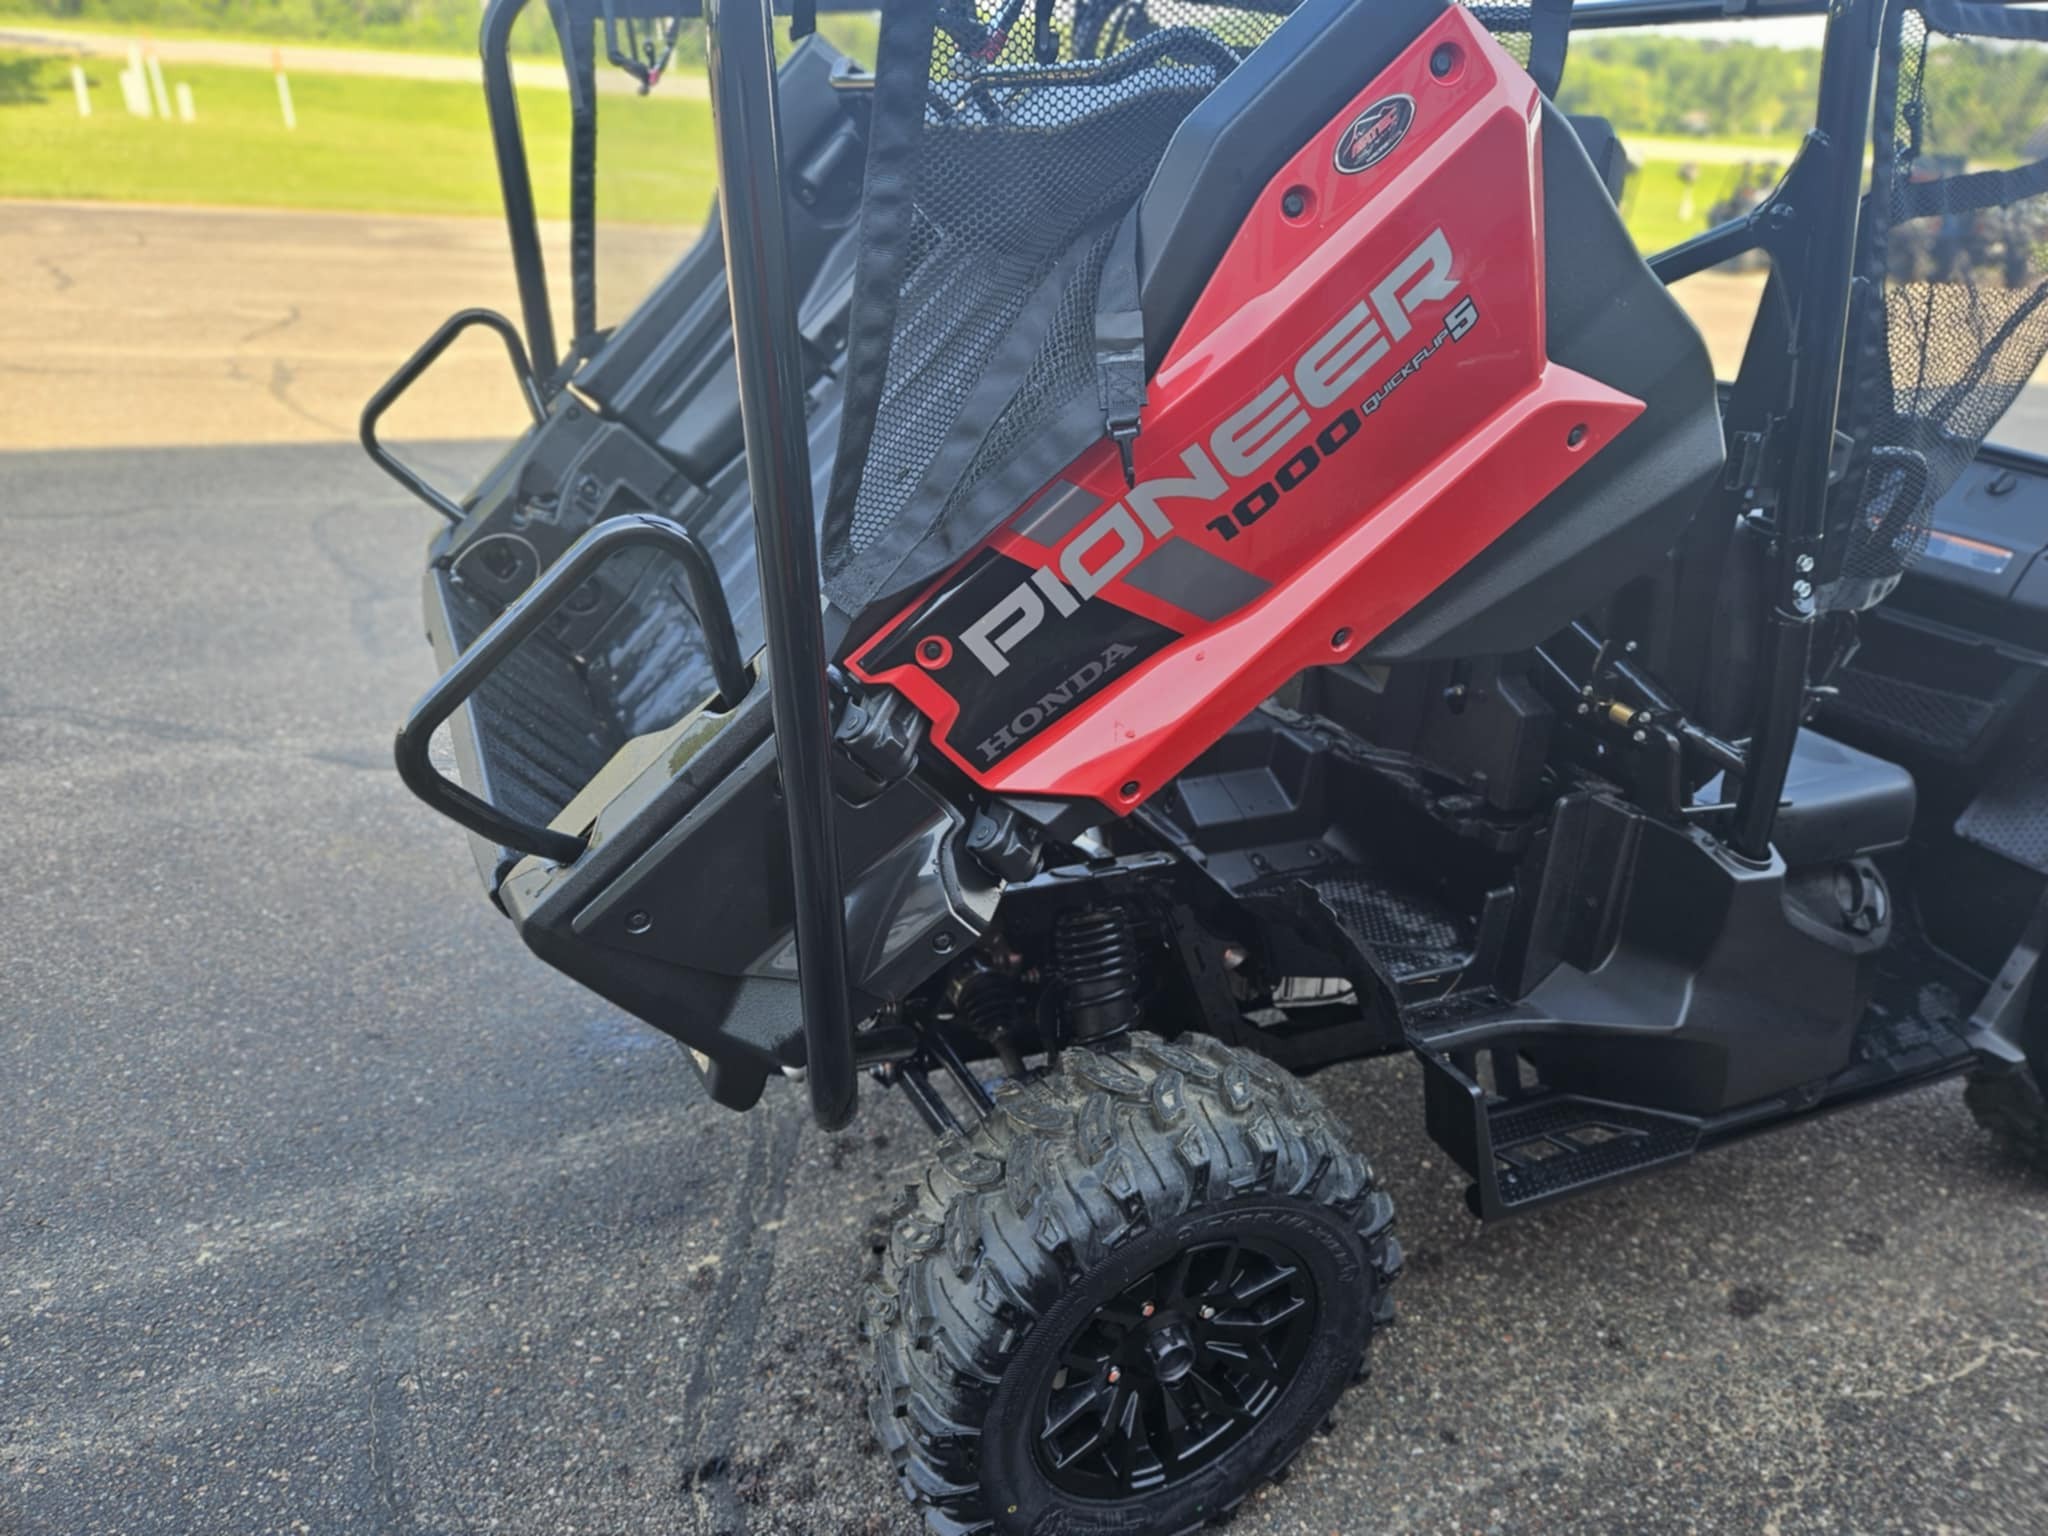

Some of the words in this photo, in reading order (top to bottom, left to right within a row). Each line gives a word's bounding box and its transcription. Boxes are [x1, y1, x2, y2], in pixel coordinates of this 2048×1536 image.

[958, 226, 1461, 678] PIONEER
[1206, 408, 1362, 541] 1000
[976, 643, 1138, 761] HONDA
